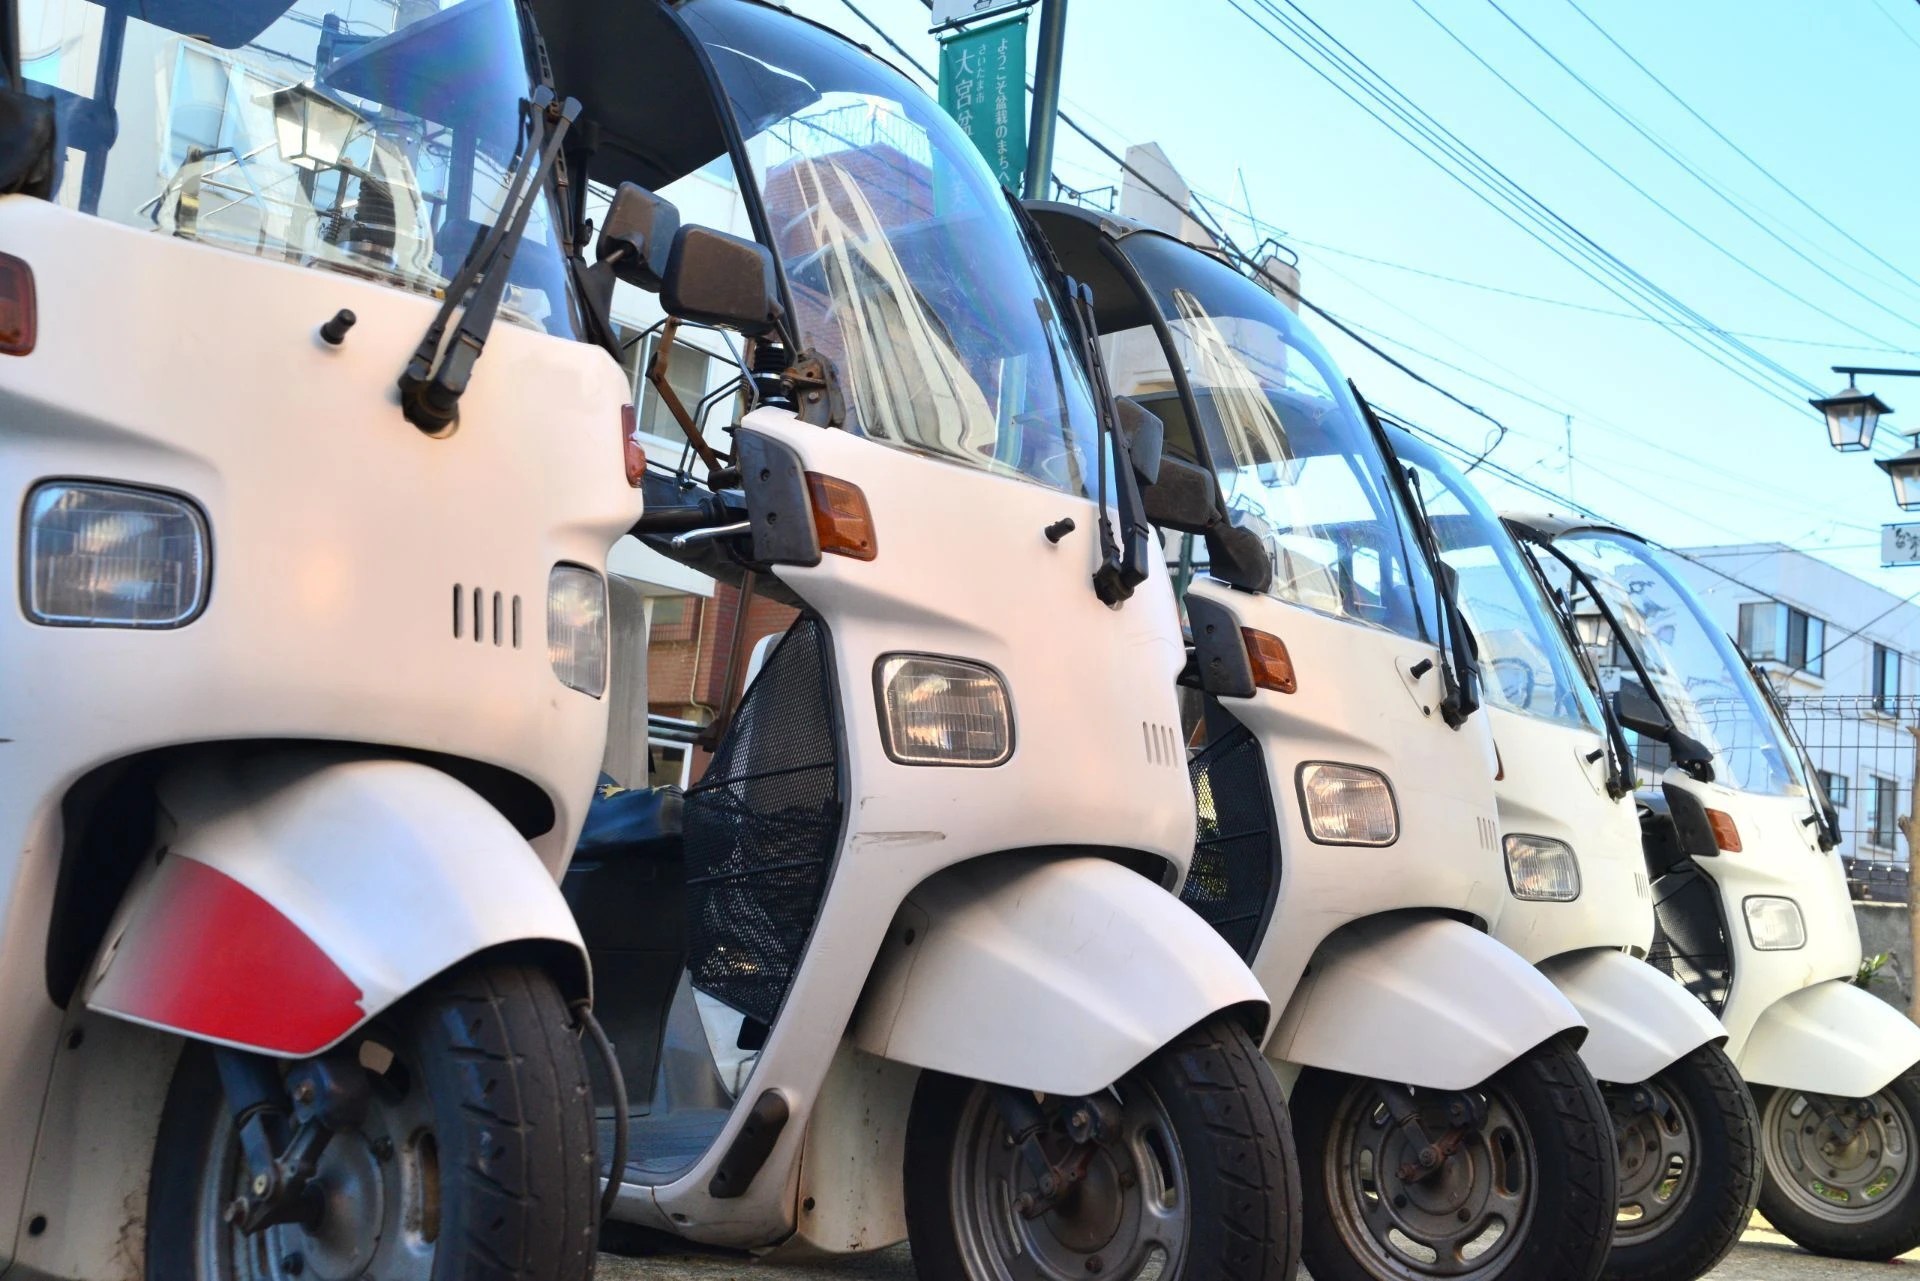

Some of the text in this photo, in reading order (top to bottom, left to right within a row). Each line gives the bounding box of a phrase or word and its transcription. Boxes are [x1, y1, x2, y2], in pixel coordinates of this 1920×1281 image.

[976, 44, 986, 104] さいたま市
[995, 38, 1010, 182] ようこそ盆栽のまちへ
